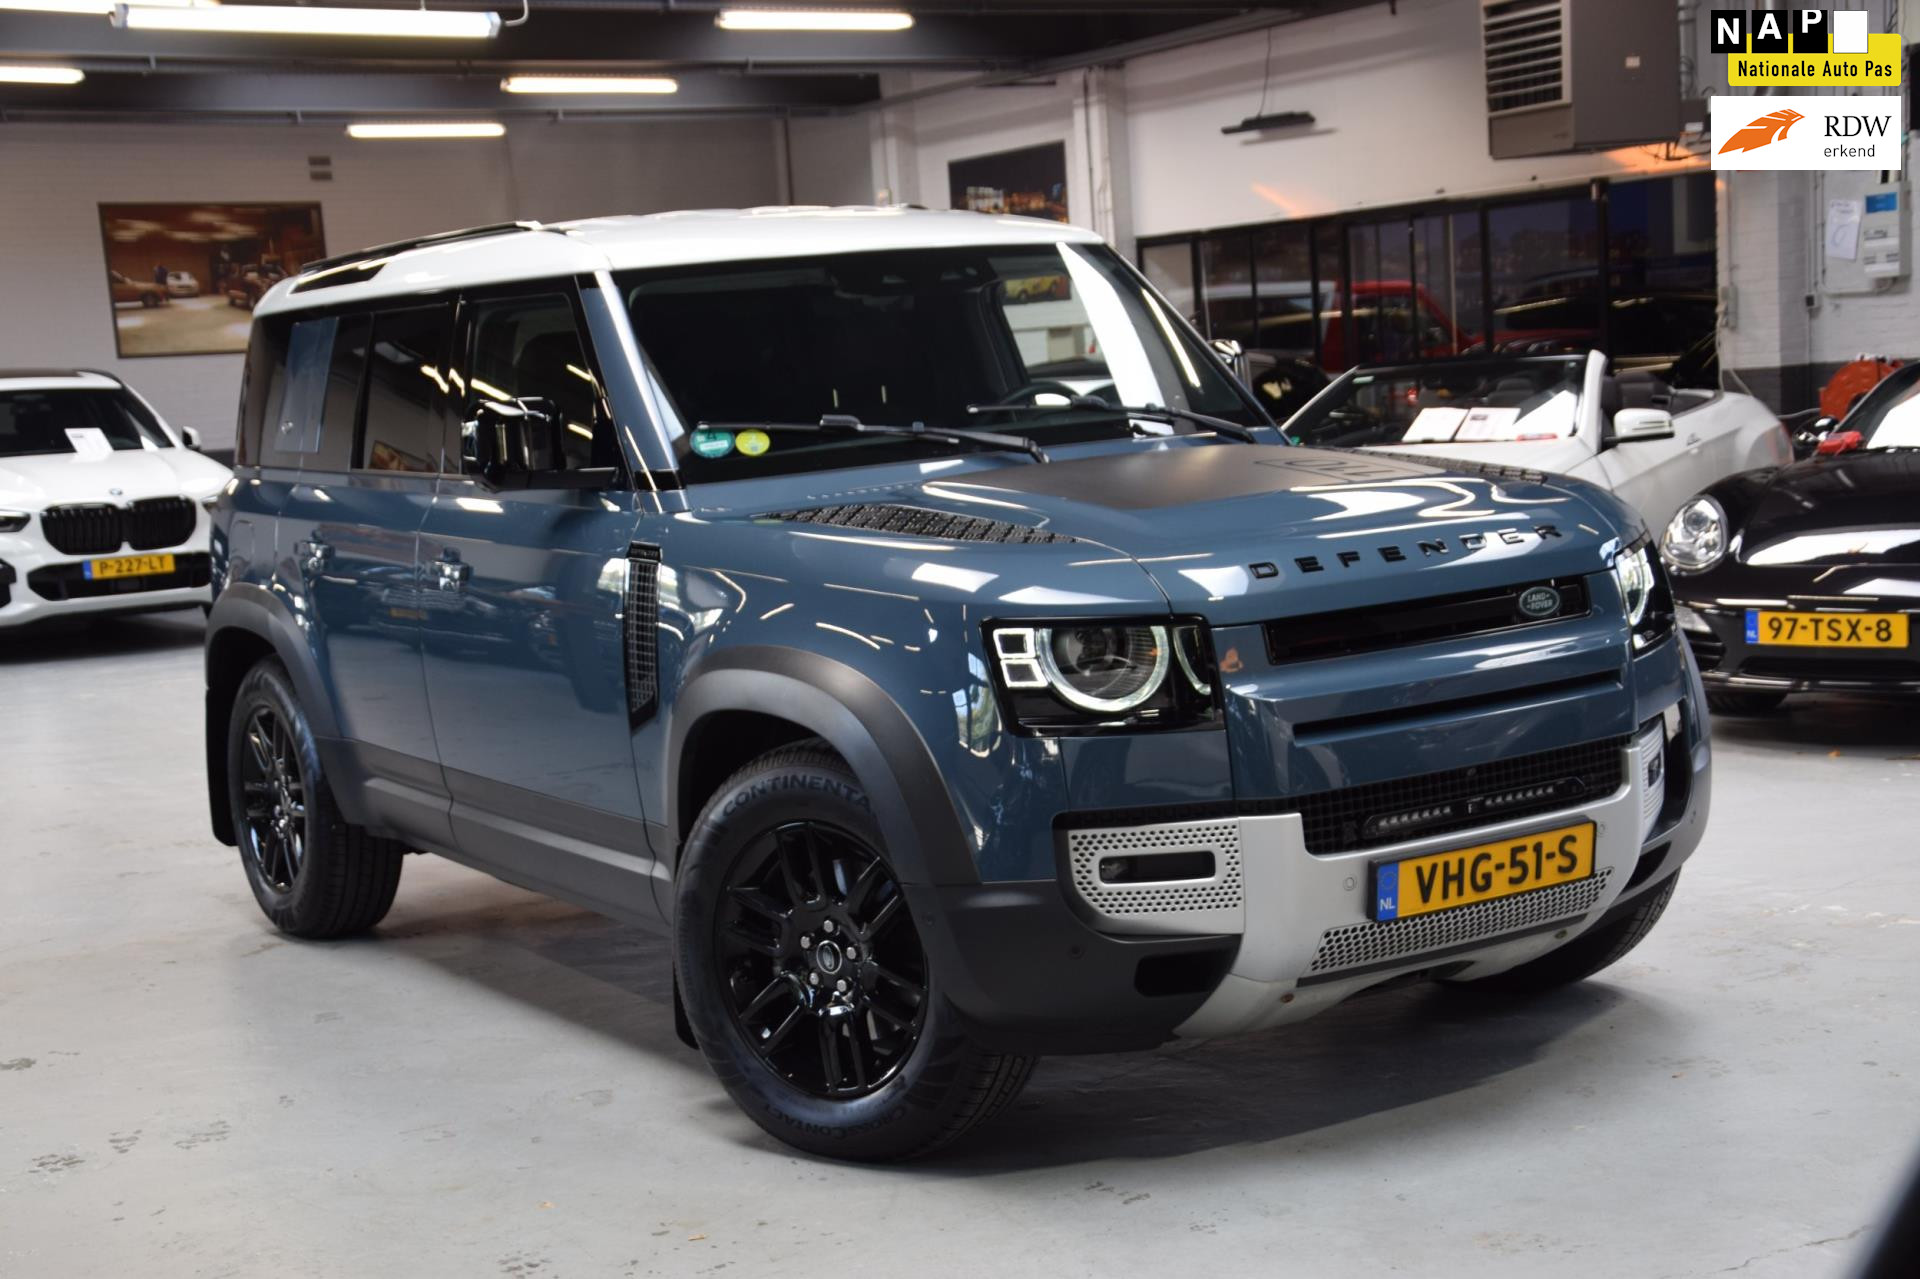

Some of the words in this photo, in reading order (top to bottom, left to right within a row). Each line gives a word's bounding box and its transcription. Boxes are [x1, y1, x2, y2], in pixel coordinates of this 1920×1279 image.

[100, 556, 166, 575] P-227-LT
[1249, 525, 1564, 579] DEFENDER
[1768, 617, 1892, 642] 97-TSX-8
[722, 774, 872, 817] CONTINENTA
[1416, 834, 1577, 904] VHG-51-S
[1380, 897, 1396, 911] NL
